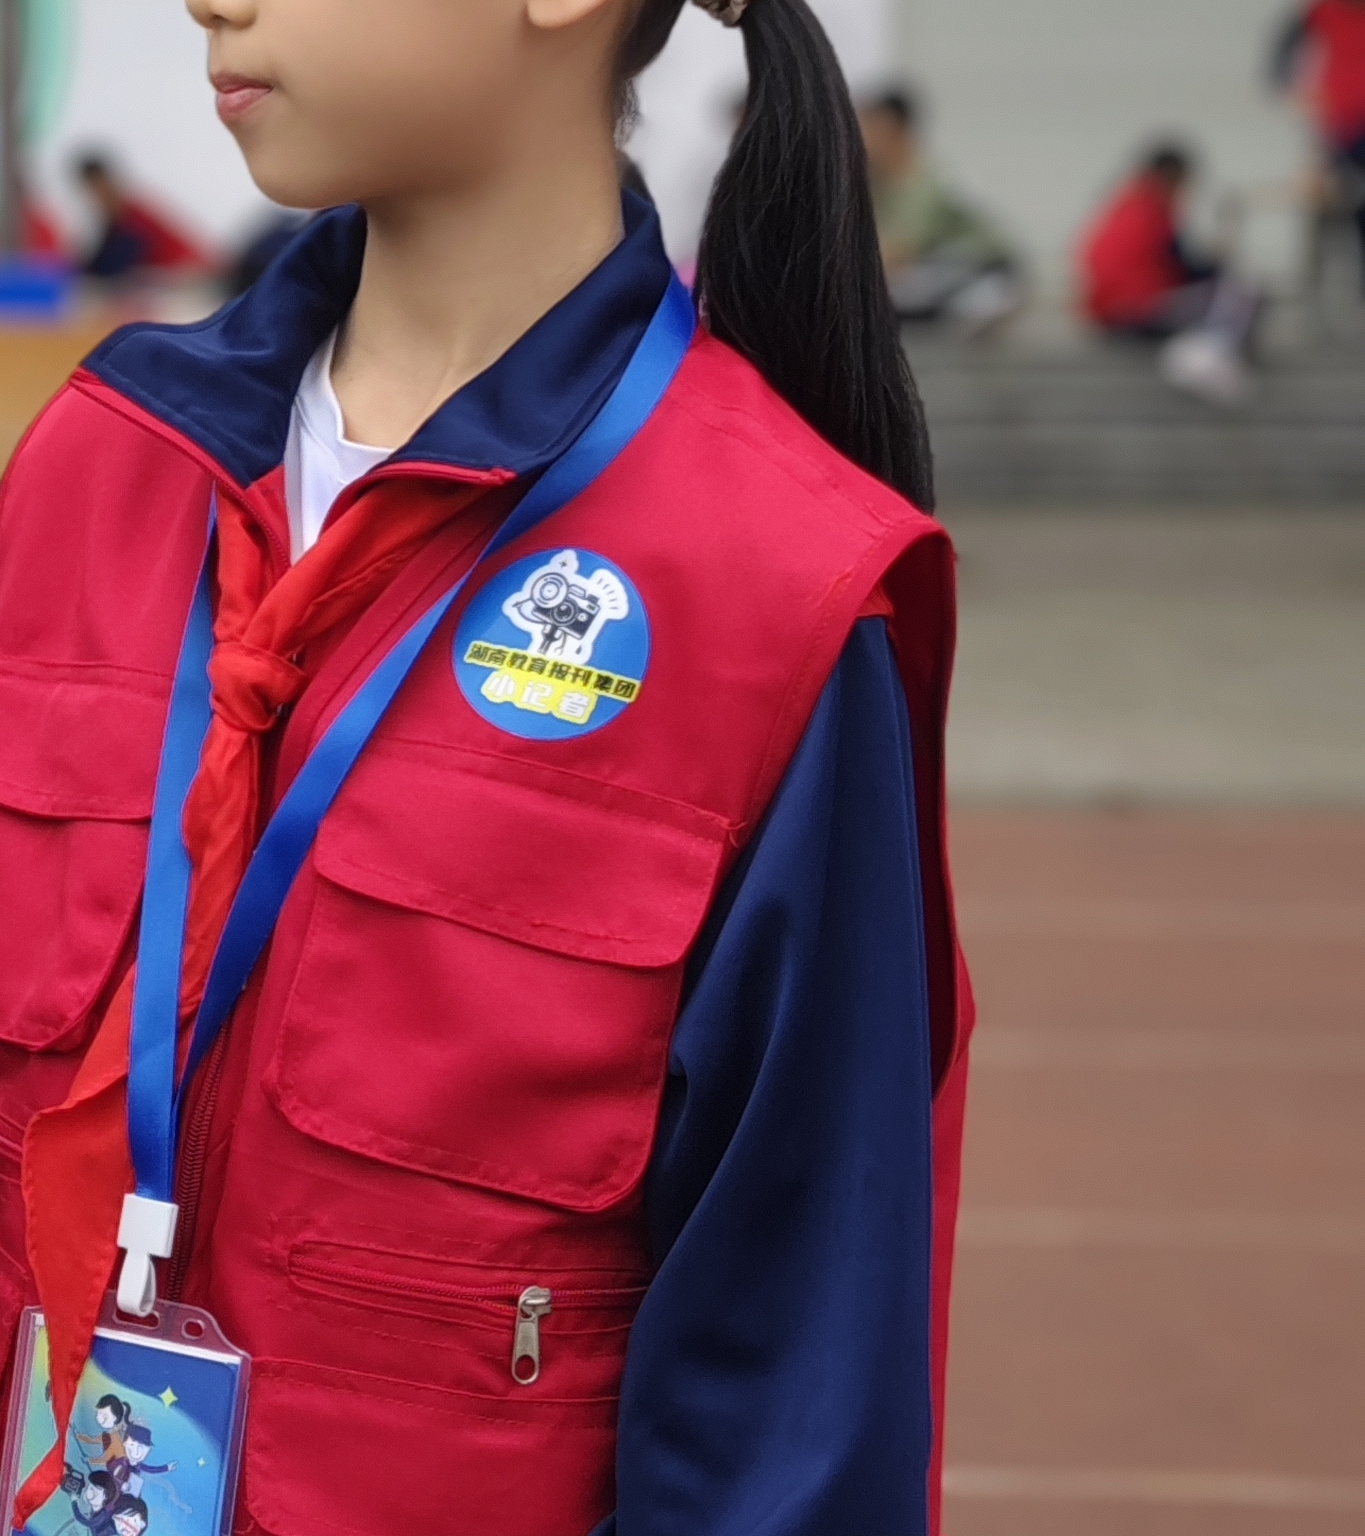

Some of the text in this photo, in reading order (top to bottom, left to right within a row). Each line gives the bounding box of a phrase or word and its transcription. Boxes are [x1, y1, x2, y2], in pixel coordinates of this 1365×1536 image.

[466, 643, 638, 699] 湖南教育报刊集团
[488, 674, 591, 718] 小记者
